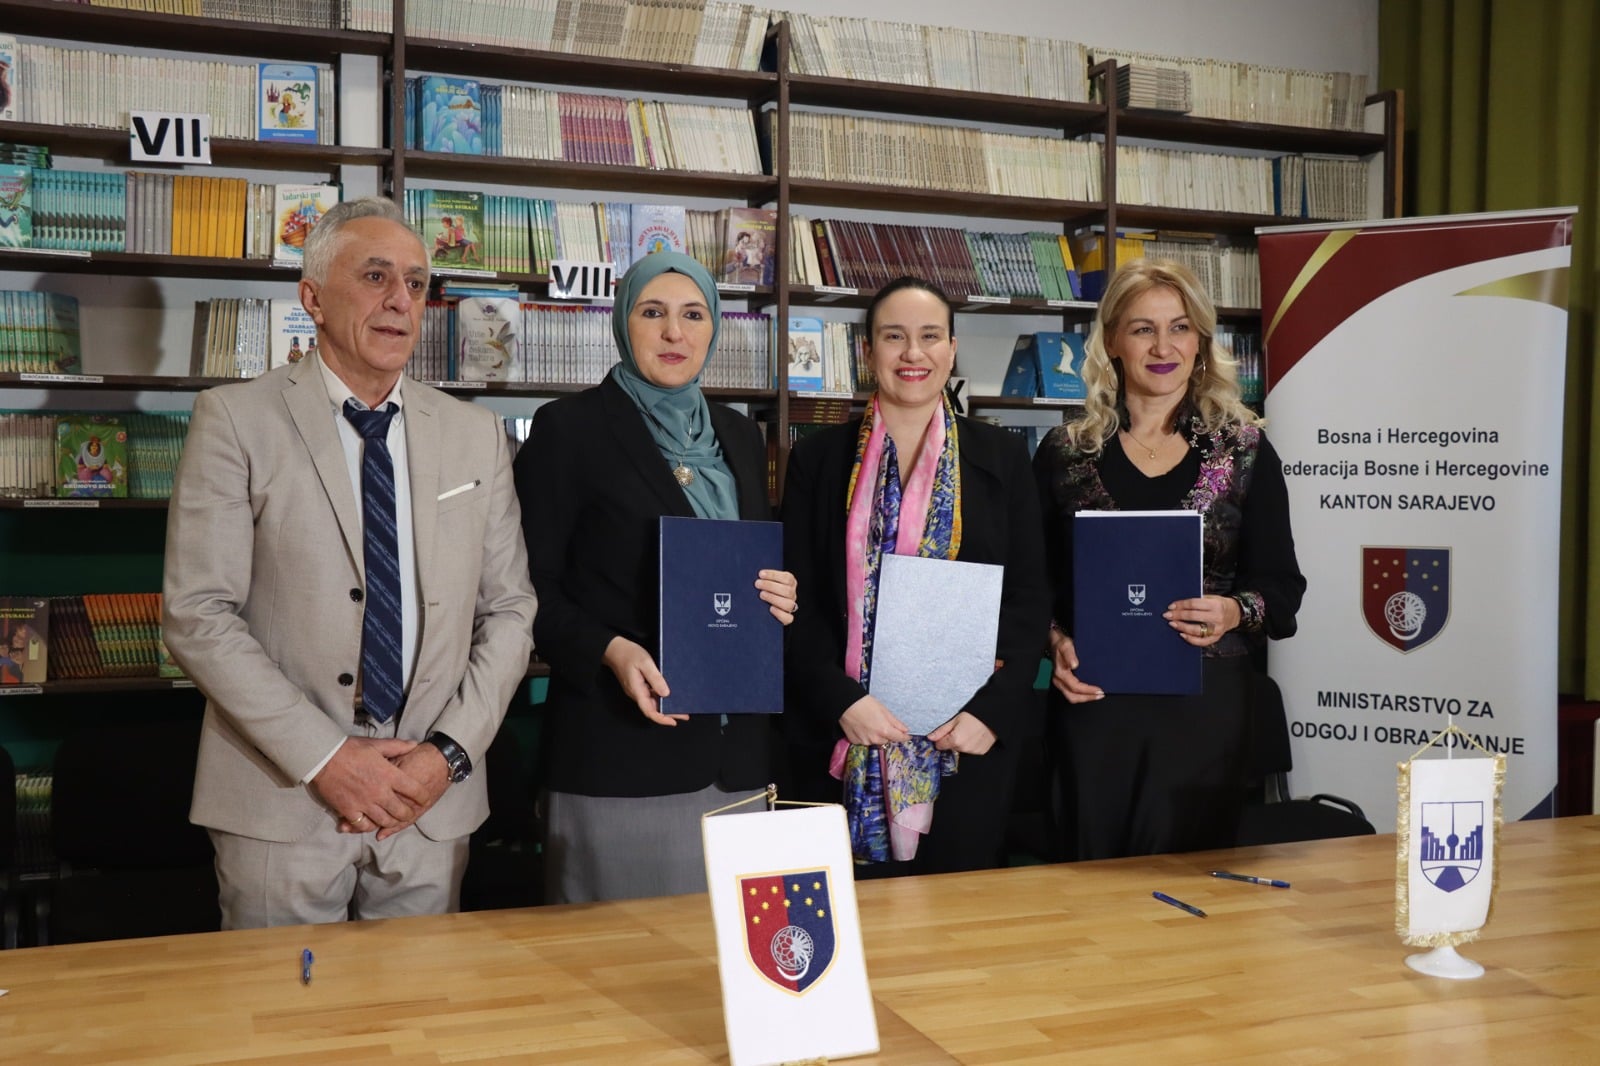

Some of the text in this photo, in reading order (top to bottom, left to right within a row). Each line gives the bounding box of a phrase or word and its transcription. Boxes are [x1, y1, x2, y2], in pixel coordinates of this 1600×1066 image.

[132, 116, 201, 157] VII
[551, 265, 611, 297] VIII
[1317, 427, 1499, 447] Bosna i Hercegovina
[1281, 460, 1549, 480] ederacija Bosne i Hercegovine
[1319, 494, 1496, 511] KANTON SARAJEVO
[1317, 690, 1495, 718] MINISTARSTVO ZA
[1290, 721, 1525, 755] ODGOJ I OBRAZOVANJE
